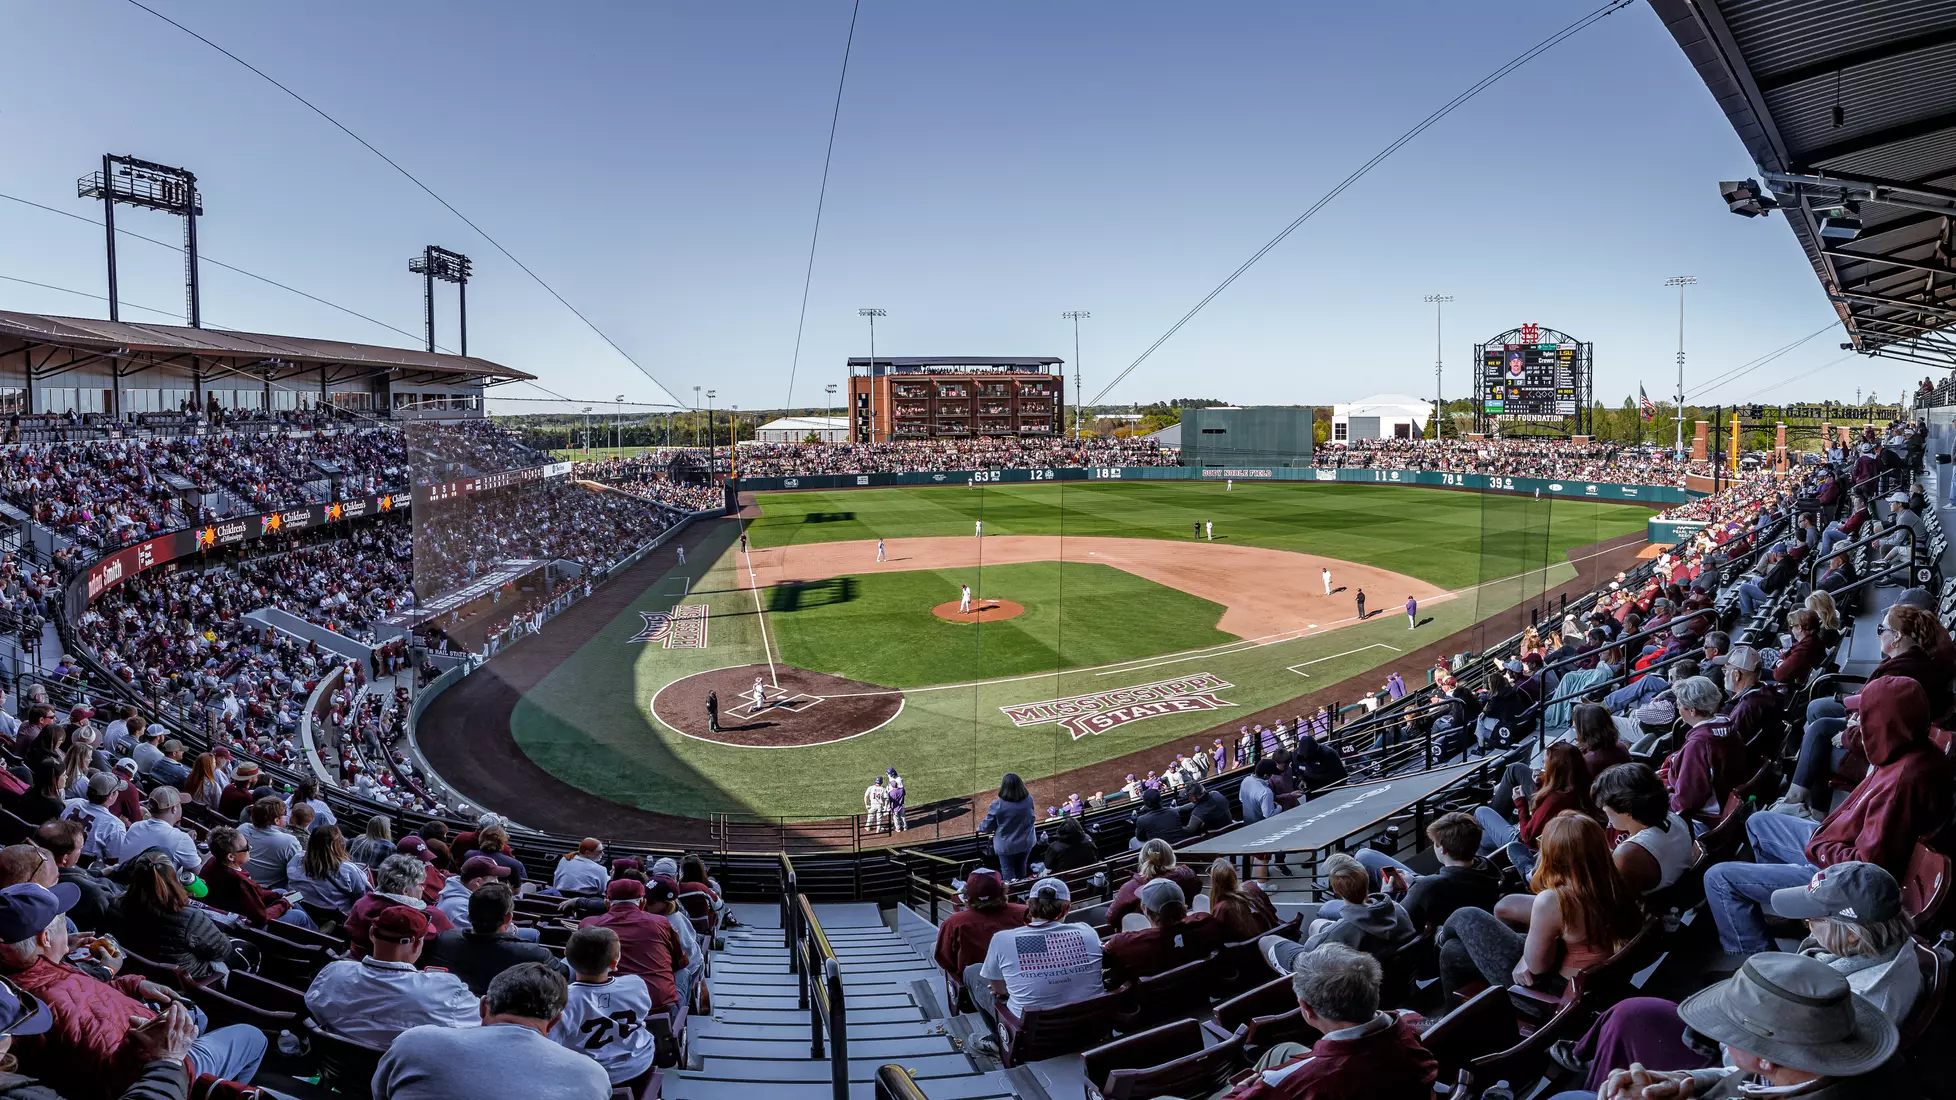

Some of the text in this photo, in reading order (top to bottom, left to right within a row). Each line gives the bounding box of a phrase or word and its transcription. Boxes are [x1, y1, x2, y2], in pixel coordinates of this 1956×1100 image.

[974, 472, 988, 482] 63
[1030, 470, 1042, 480] 12
[1096, 468, 1109, 478] 18
[1375, 471, 1387, 481] 11
[1442, 474, 1454, 484] 78
[1490, 477, 1502, 488] 39
[342, 500, 366, 512] Children's
[283, 509, 310, 522] Children's
[217, 521, 247, 536] Children's
[103, 559, 122, 586] Smith
[1006, 676, 1226, 722] MISSISSIPPI
[1091, 700, 1198, 728] STATE
[1020, 968, 1068, 979] vineyard
